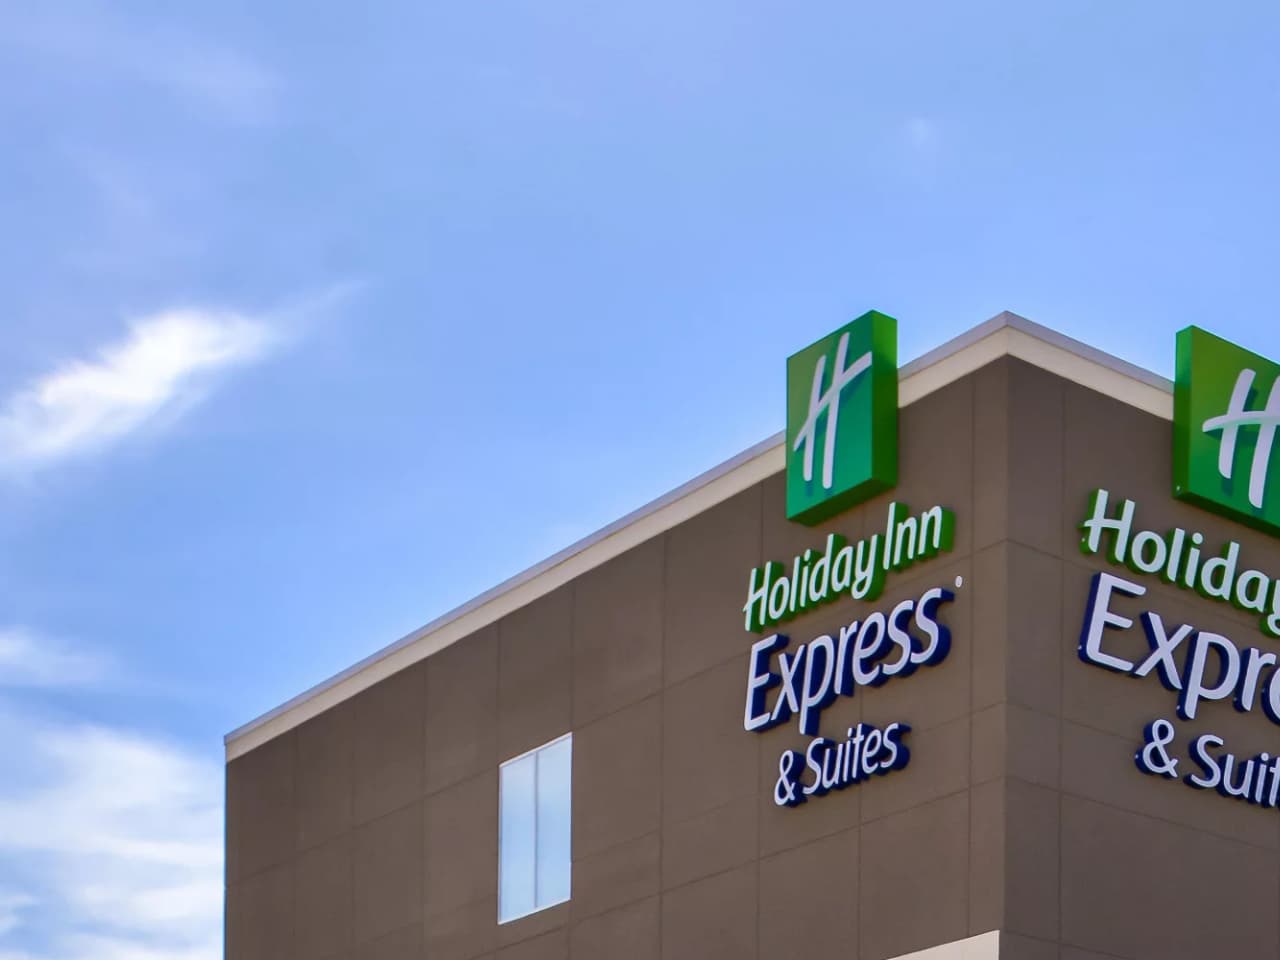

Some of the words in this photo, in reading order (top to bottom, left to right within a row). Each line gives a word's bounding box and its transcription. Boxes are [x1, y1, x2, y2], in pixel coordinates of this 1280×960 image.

[742, 533, 879, 632] Holiday
[882, 501, 943, 571] Inn
[743, 587, 943, 736] Express
[773, 749, 797, 807] &
[802, 722, 900, 796] Suites
[1141, 718, 1179, 779] &
